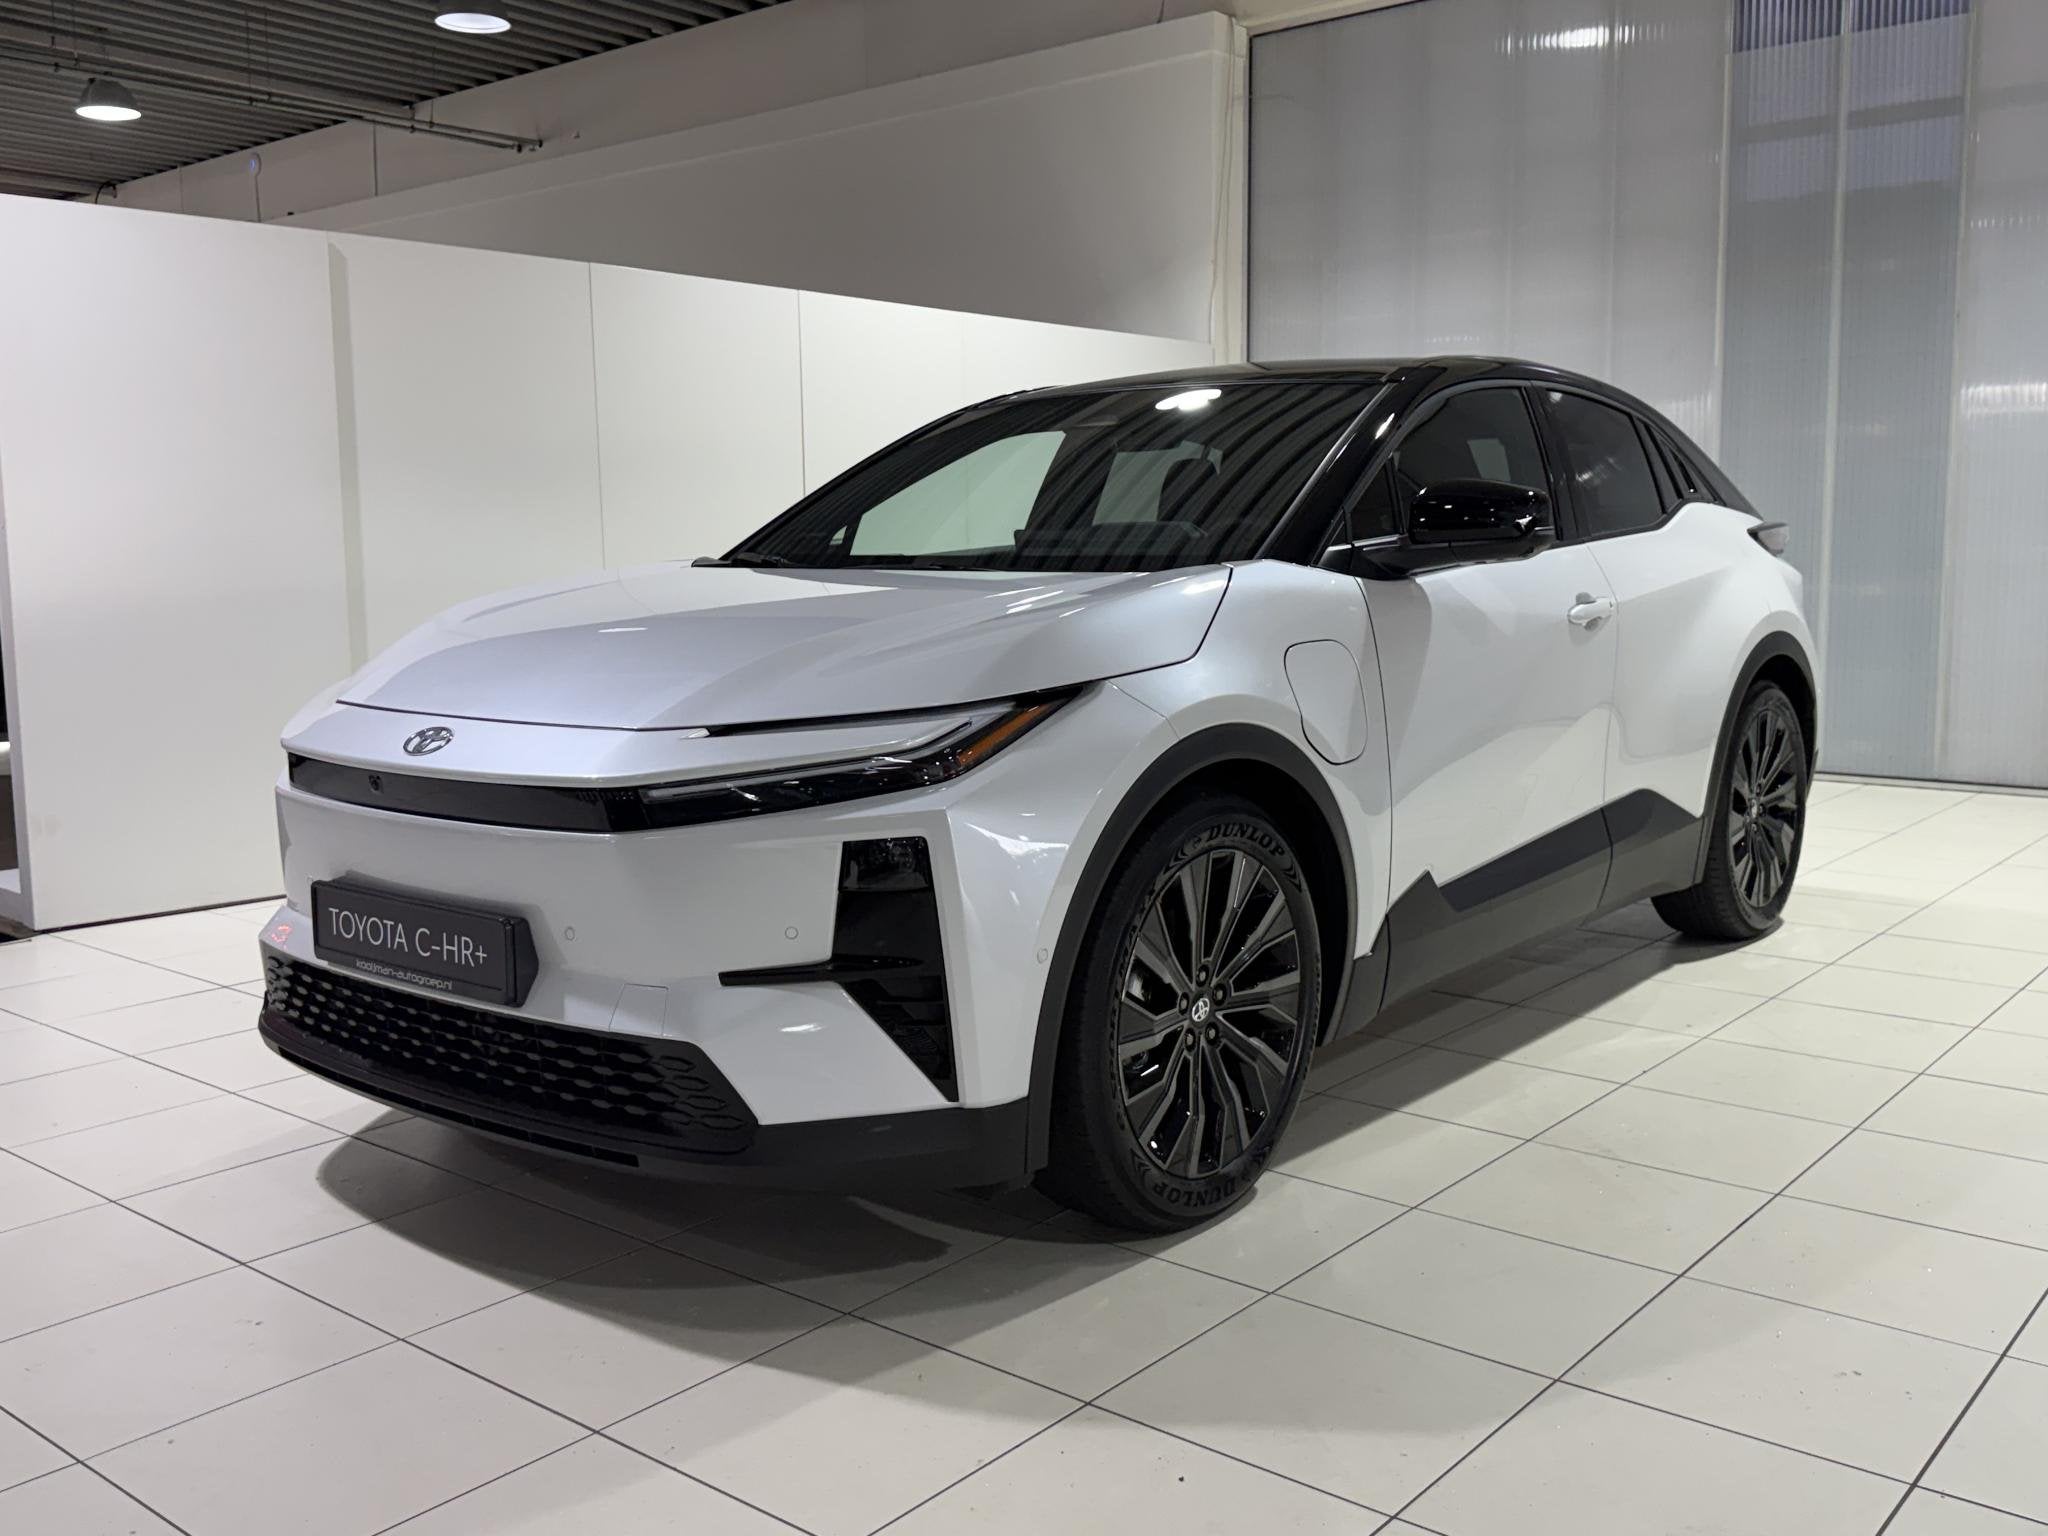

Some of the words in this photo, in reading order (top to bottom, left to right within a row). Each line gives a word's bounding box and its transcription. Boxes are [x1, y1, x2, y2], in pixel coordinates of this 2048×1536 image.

[1208, 822, 1285, 857] DUNLOP
[328, 907, 408, 952] TOYOTA
[415, 927, 487, 967] C-HR+
[1153, 1177, 1235, 1208] DUNLOP
